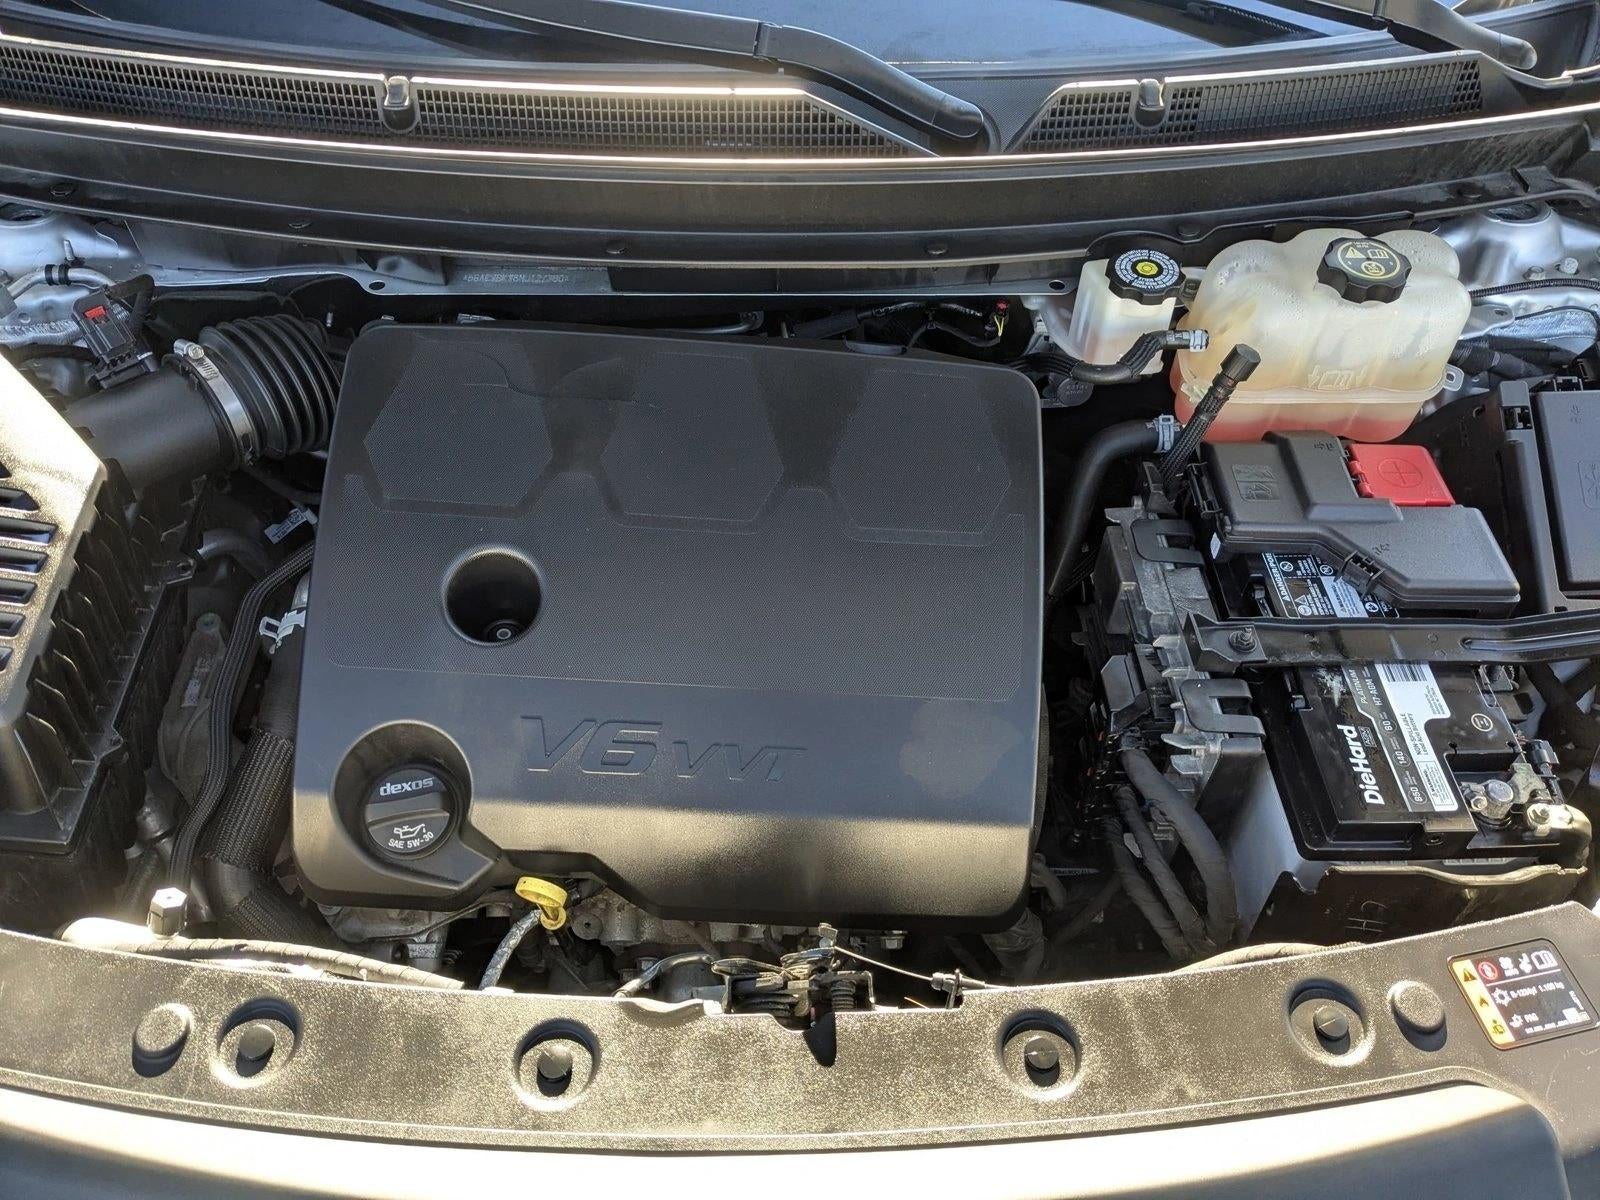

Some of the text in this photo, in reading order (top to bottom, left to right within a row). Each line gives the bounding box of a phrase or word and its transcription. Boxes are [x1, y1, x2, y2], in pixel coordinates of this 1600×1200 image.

[1349, 669, 1368, 704] PLATINUM
[1365, 678, 1383, 706] H7-AGM
[1382, 720, 1393, 731] 80
[1400, 713, 1421, 755] NON-SPILLABLE
[520, 716, 808, 782] V6 VVT
[1395, 751, 1407, 765] 140
[1336, 724, 1385, 805] DieHard
[380, 777, 433, 796] dexos
[1410, 786, 1423, 802] 850
[388, 831, 434, 848] SAE 5W-30
